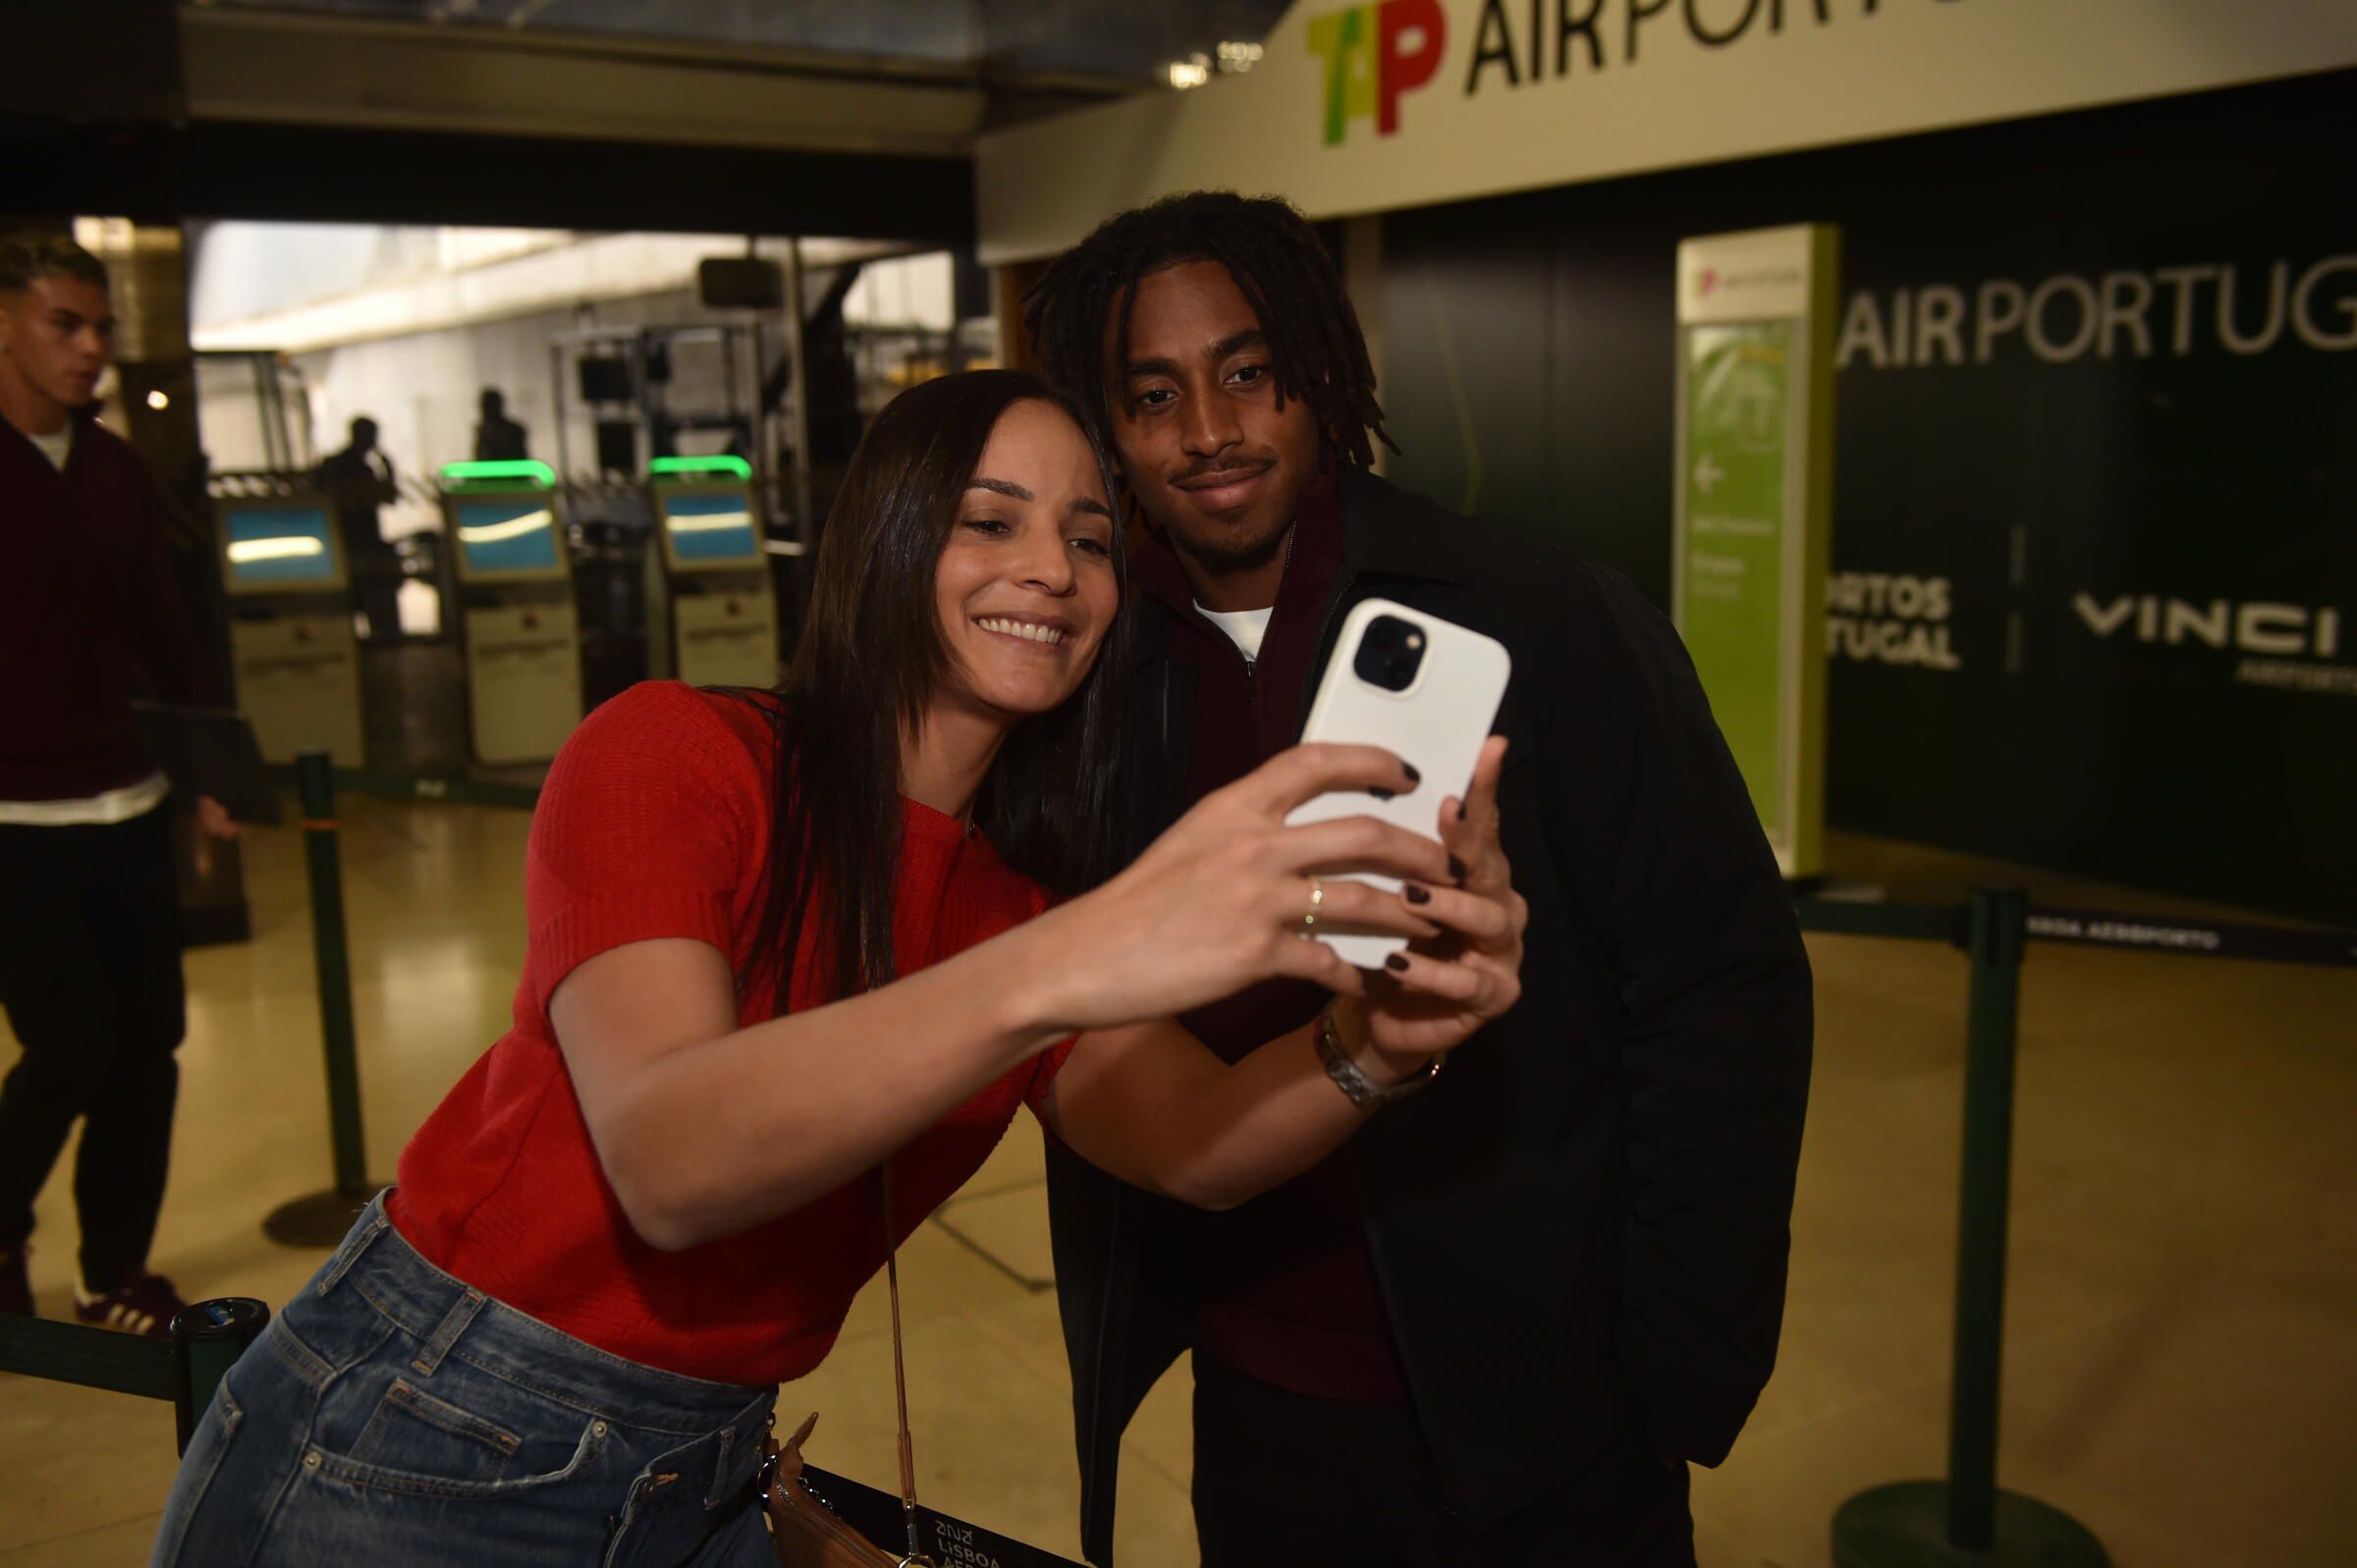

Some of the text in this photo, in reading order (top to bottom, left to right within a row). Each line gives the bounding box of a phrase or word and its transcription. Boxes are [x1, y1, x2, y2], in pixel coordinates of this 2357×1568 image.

[1307, 0, 1968, 146] TAP AIRP
[1836, 257, 2357, 367] AIRPORTUG
[2073, 593, 2338, 656] VINCI
[2088, 923, 2219, 948] AEROPORTO
